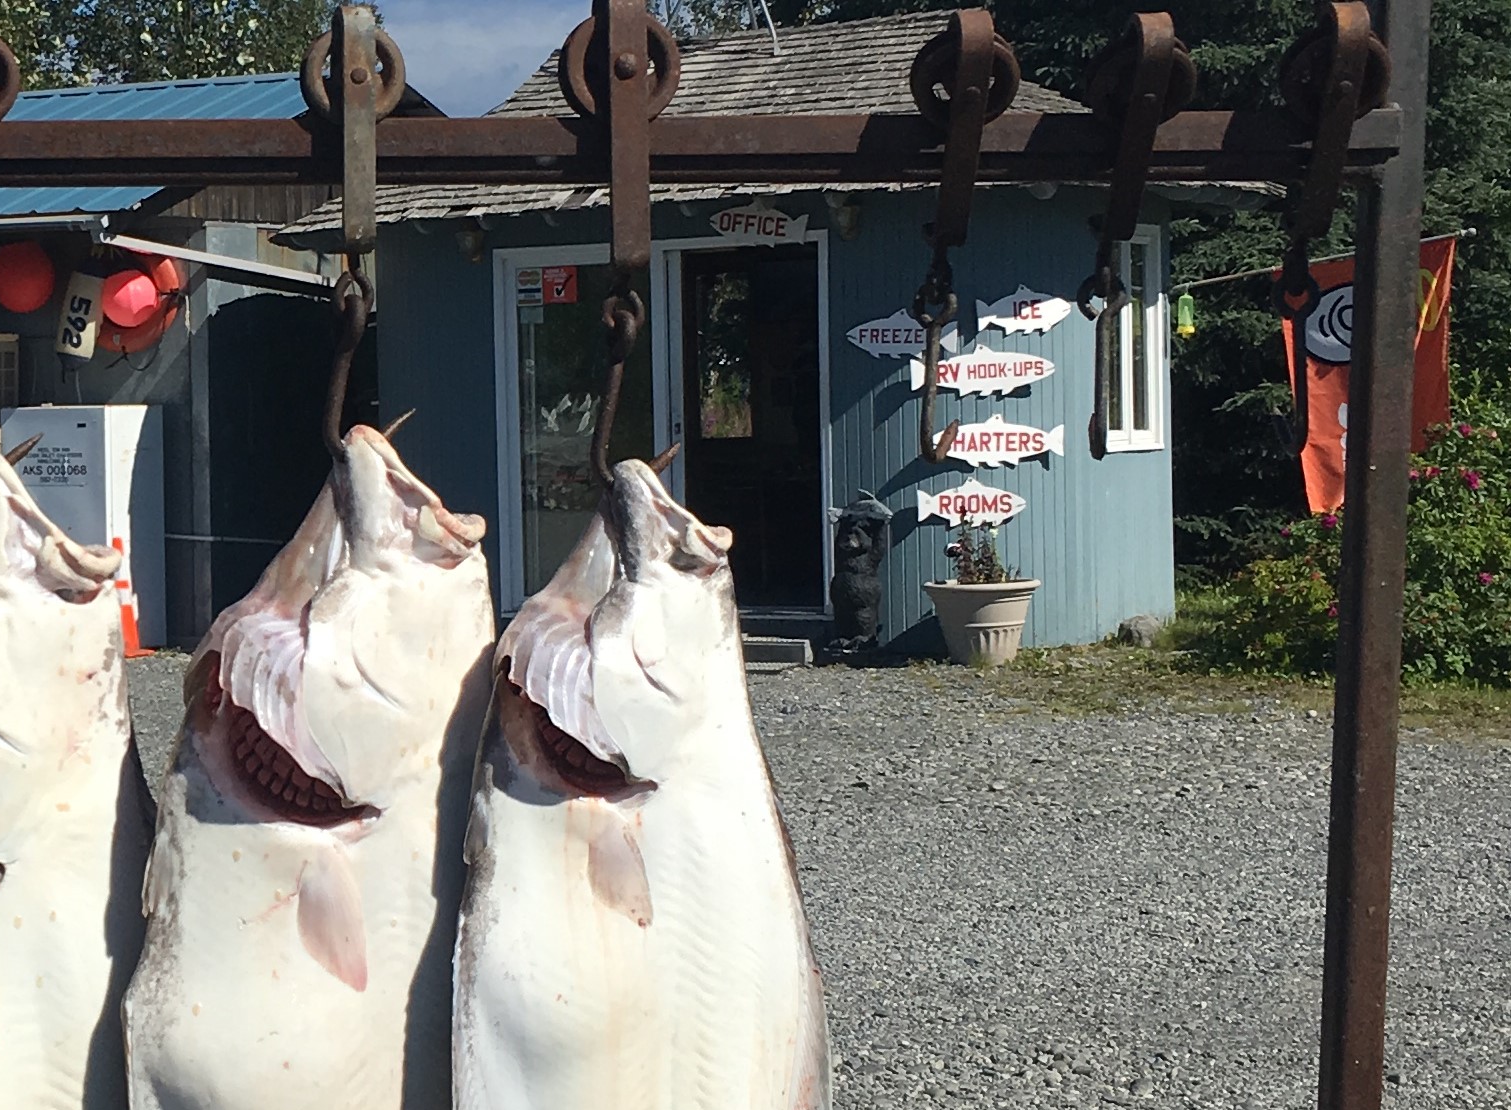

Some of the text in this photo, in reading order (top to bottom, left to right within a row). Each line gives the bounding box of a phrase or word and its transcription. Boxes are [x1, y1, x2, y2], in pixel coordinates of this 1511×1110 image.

[719, 212, 788, 237] OFFICE
[1013, 298, 1043, 320] ICE
[61, 295, 92, 349] 592
[858, 328, 925, 344] FREEZE
[936, 360, 1044, 384] RV HOOK-UPS
[951, 432, 1045, 453] HARTERS
[22, 465, 43, 476] AKS
[939, 493, 1013, 515] ROOMS
